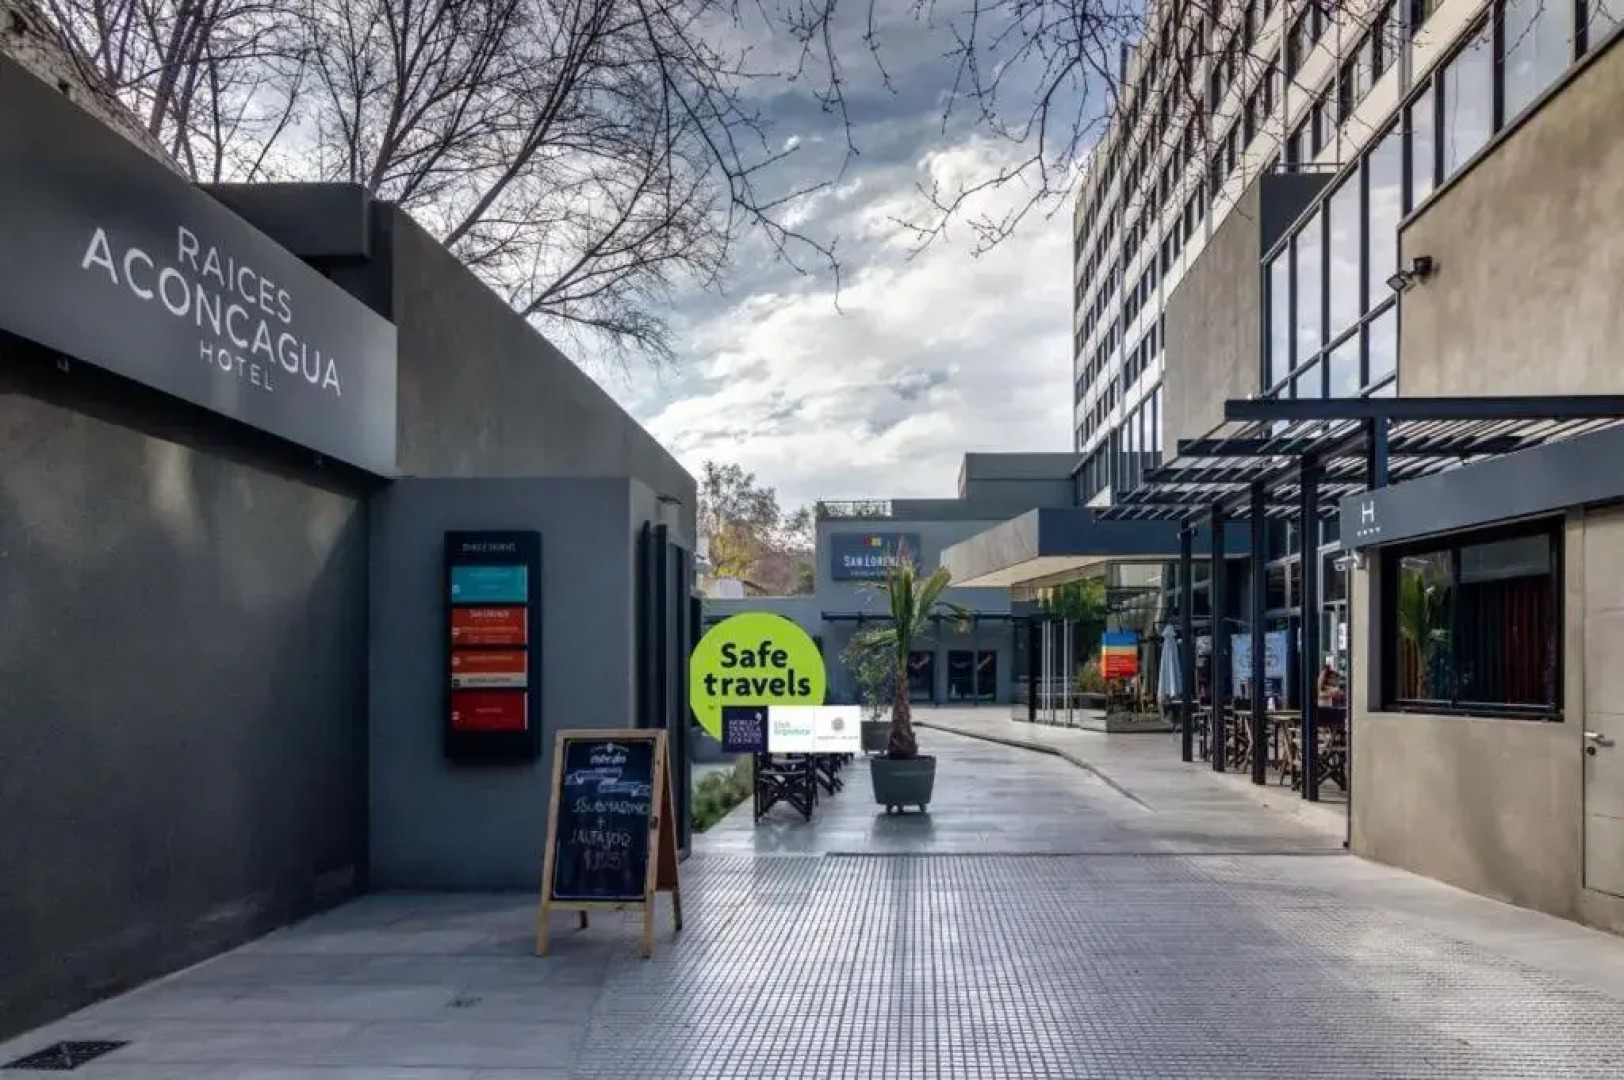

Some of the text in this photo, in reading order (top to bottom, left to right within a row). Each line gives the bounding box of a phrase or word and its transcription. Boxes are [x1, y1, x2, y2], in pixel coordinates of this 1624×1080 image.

[178, 226, 292, 323] RAICES
[82, 227, 342, 396] ACONCAGUA
[199, 340, 274, 391] HOTEL
[1361, 500, 1374, 525] H
[843, 554, 863, 567] SAN
